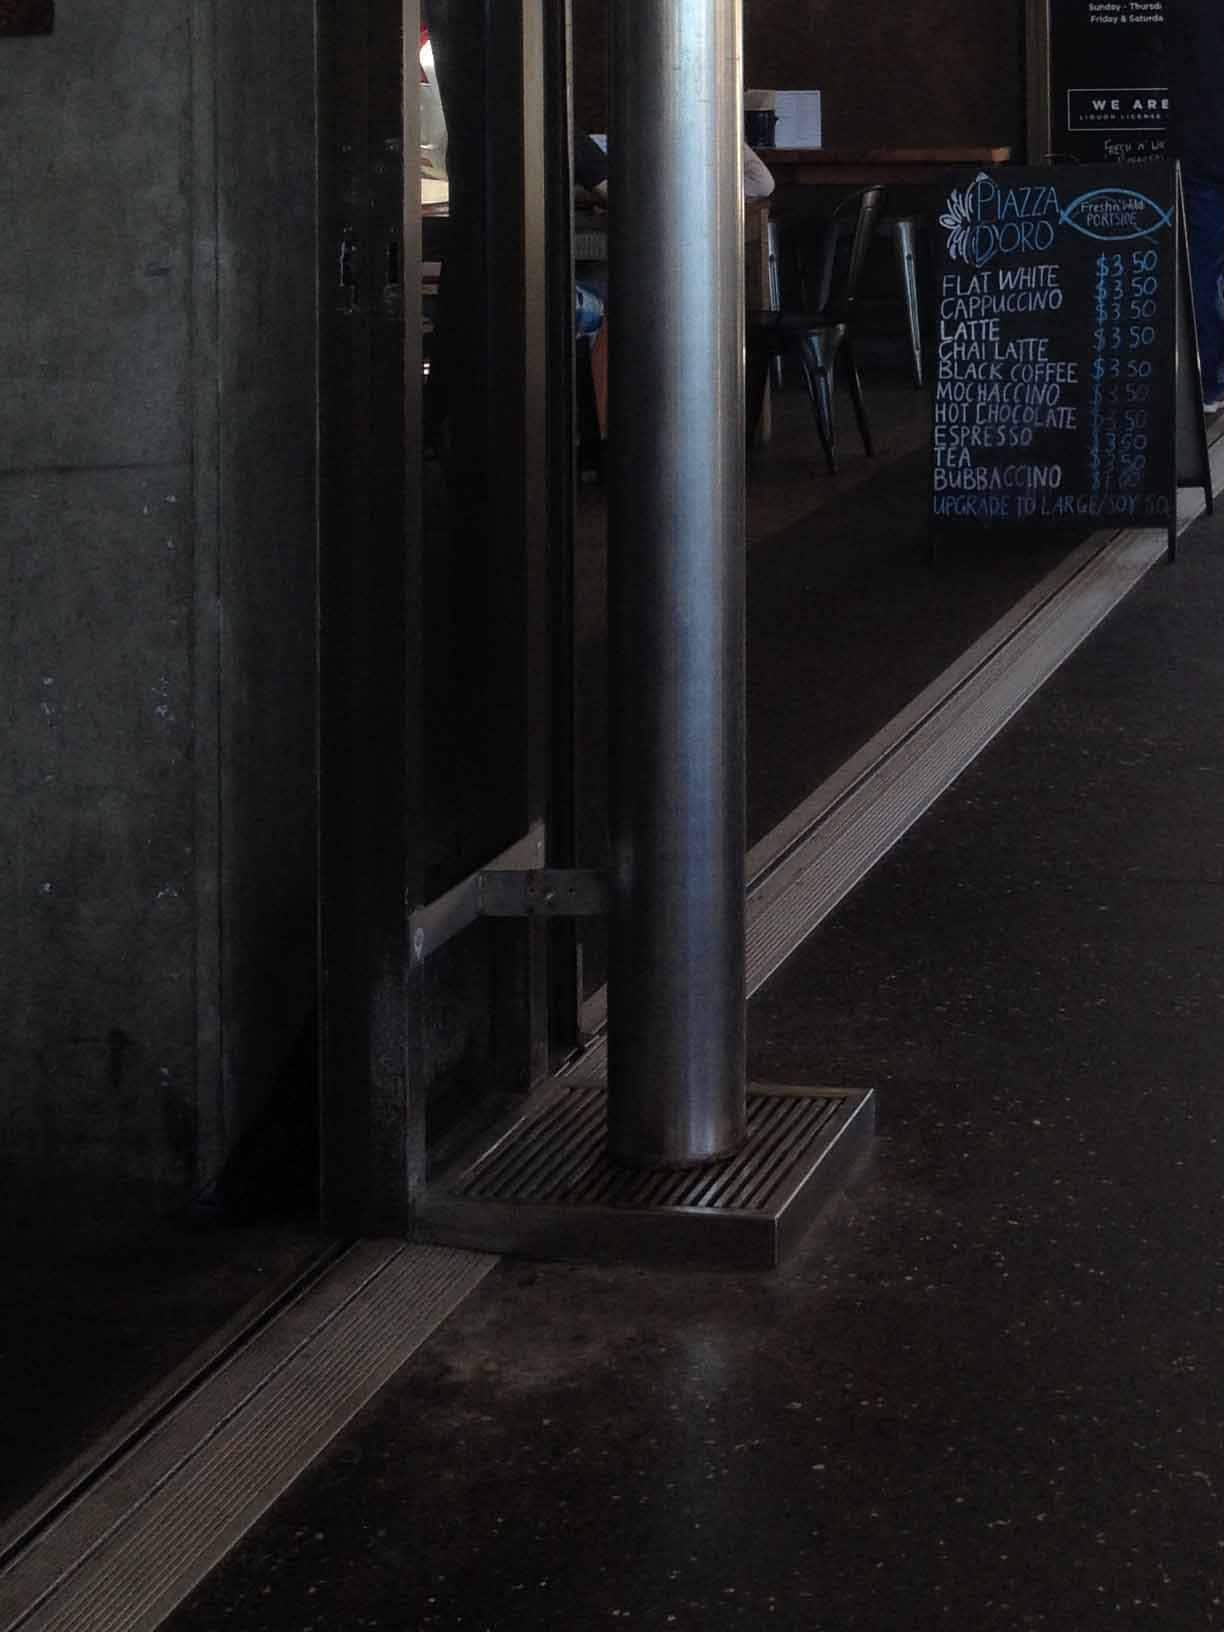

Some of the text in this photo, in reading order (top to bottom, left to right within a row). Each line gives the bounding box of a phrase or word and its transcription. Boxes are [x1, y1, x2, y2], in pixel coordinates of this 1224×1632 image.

[1128, 13, 1164, 23] Saturda
[1091, 98, 1169, 111] WE ARE
[977, 179, 1060, 221] PIAZZA
[1086, 212, 1137, 228] PORTSIDE
[942, 264, 1062, 297] FLAT WHITE
[939, 288, 1064, 320] CAPPUCCINO
[939, 318, 1001, 342] LATTE
[938, 337, 1049, 362] CHAI LATTE
[938, 359, 1079, 384] BLACK COFFEE
[936, 381, 1061, 407] MOCHACCINO
[935, 401, 1078, 430] HOT CHOCOLATE
[934, 425, 1033, 448] ESPRESSO
[934, 447, 973, 468] TEA
[933, 464, 1063, 492] BUBBACCINO
